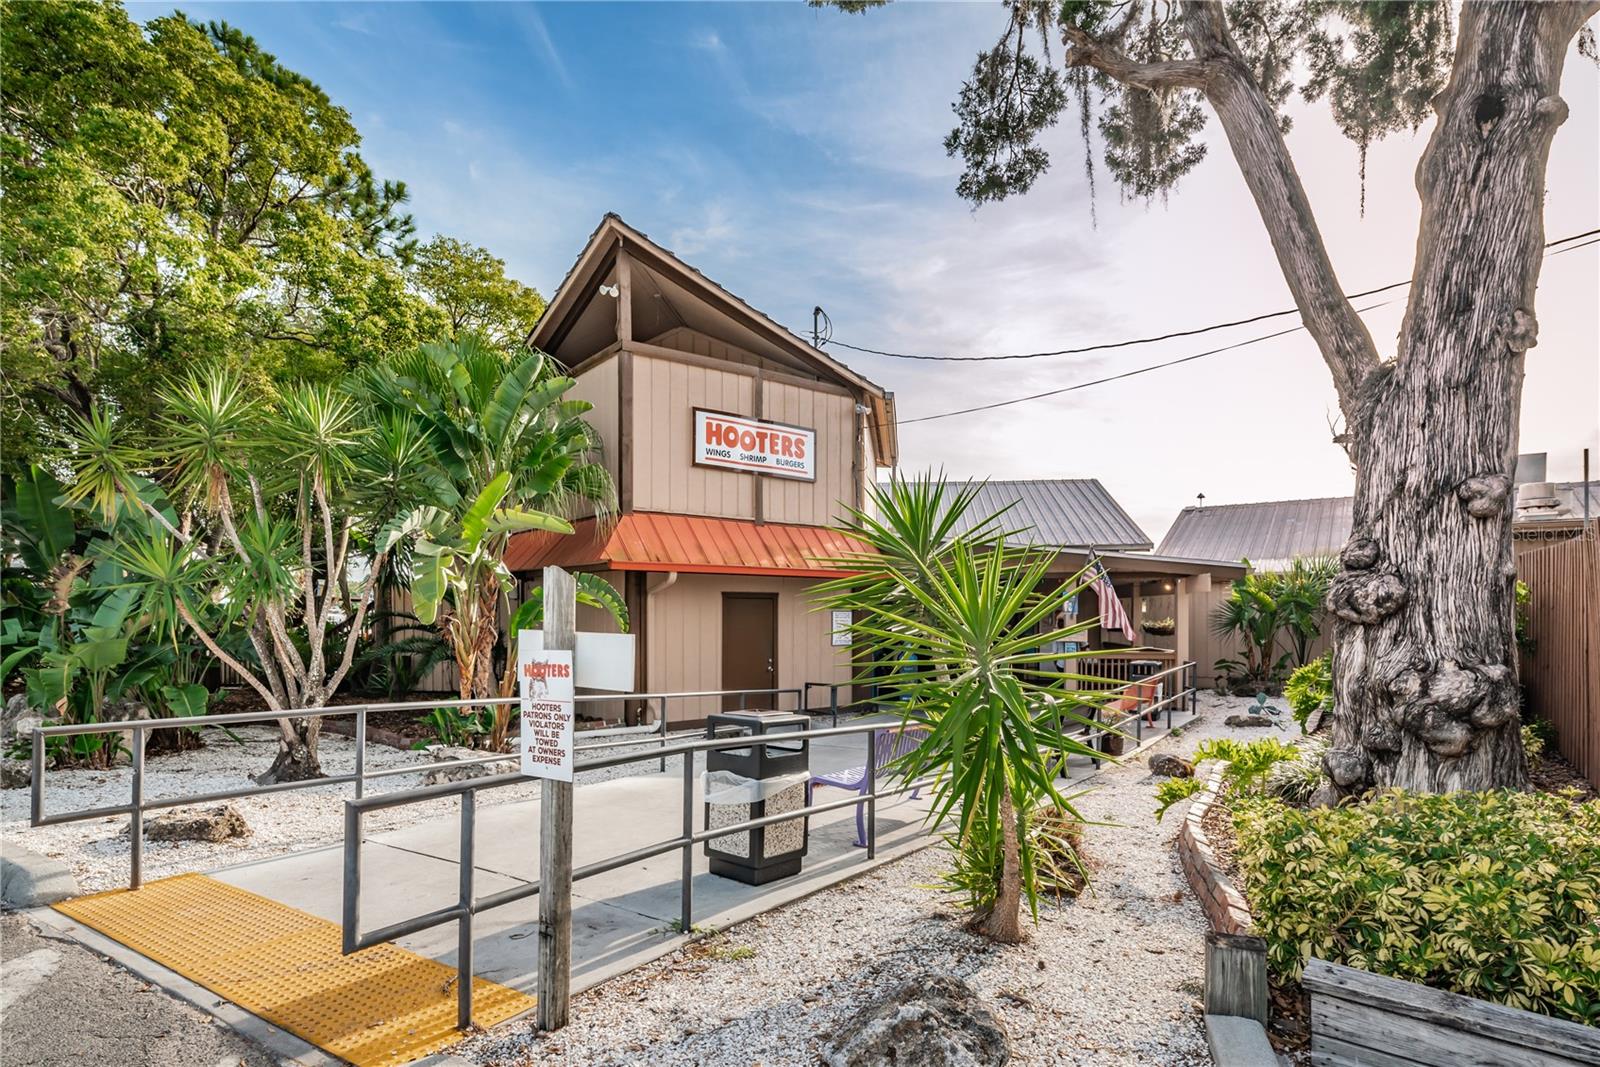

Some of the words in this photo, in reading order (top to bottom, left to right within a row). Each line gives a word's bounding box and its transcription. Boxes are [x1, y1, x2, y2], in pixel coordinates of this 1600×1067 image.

[705, 421, 805, 459] HOOTERS
[705, 448, 731, 458] WINGS
[740, 454, 767, 463] SHRIMP
[776, 458, 804, 469] BURGERS
[532, 703, 561, 712] HOOTERS
[523, 711, 551, 720] PATRONS
[554, 713, 571, 721] ONLY
[529, 720, 565, 730] VIOLATORS
[551, 731, 560, 739] BE
[535, 738, 558, 747] TOWED
[538, 747, 565, 757] OWNERS
[532, 755, 561, 766] EXPENSE
